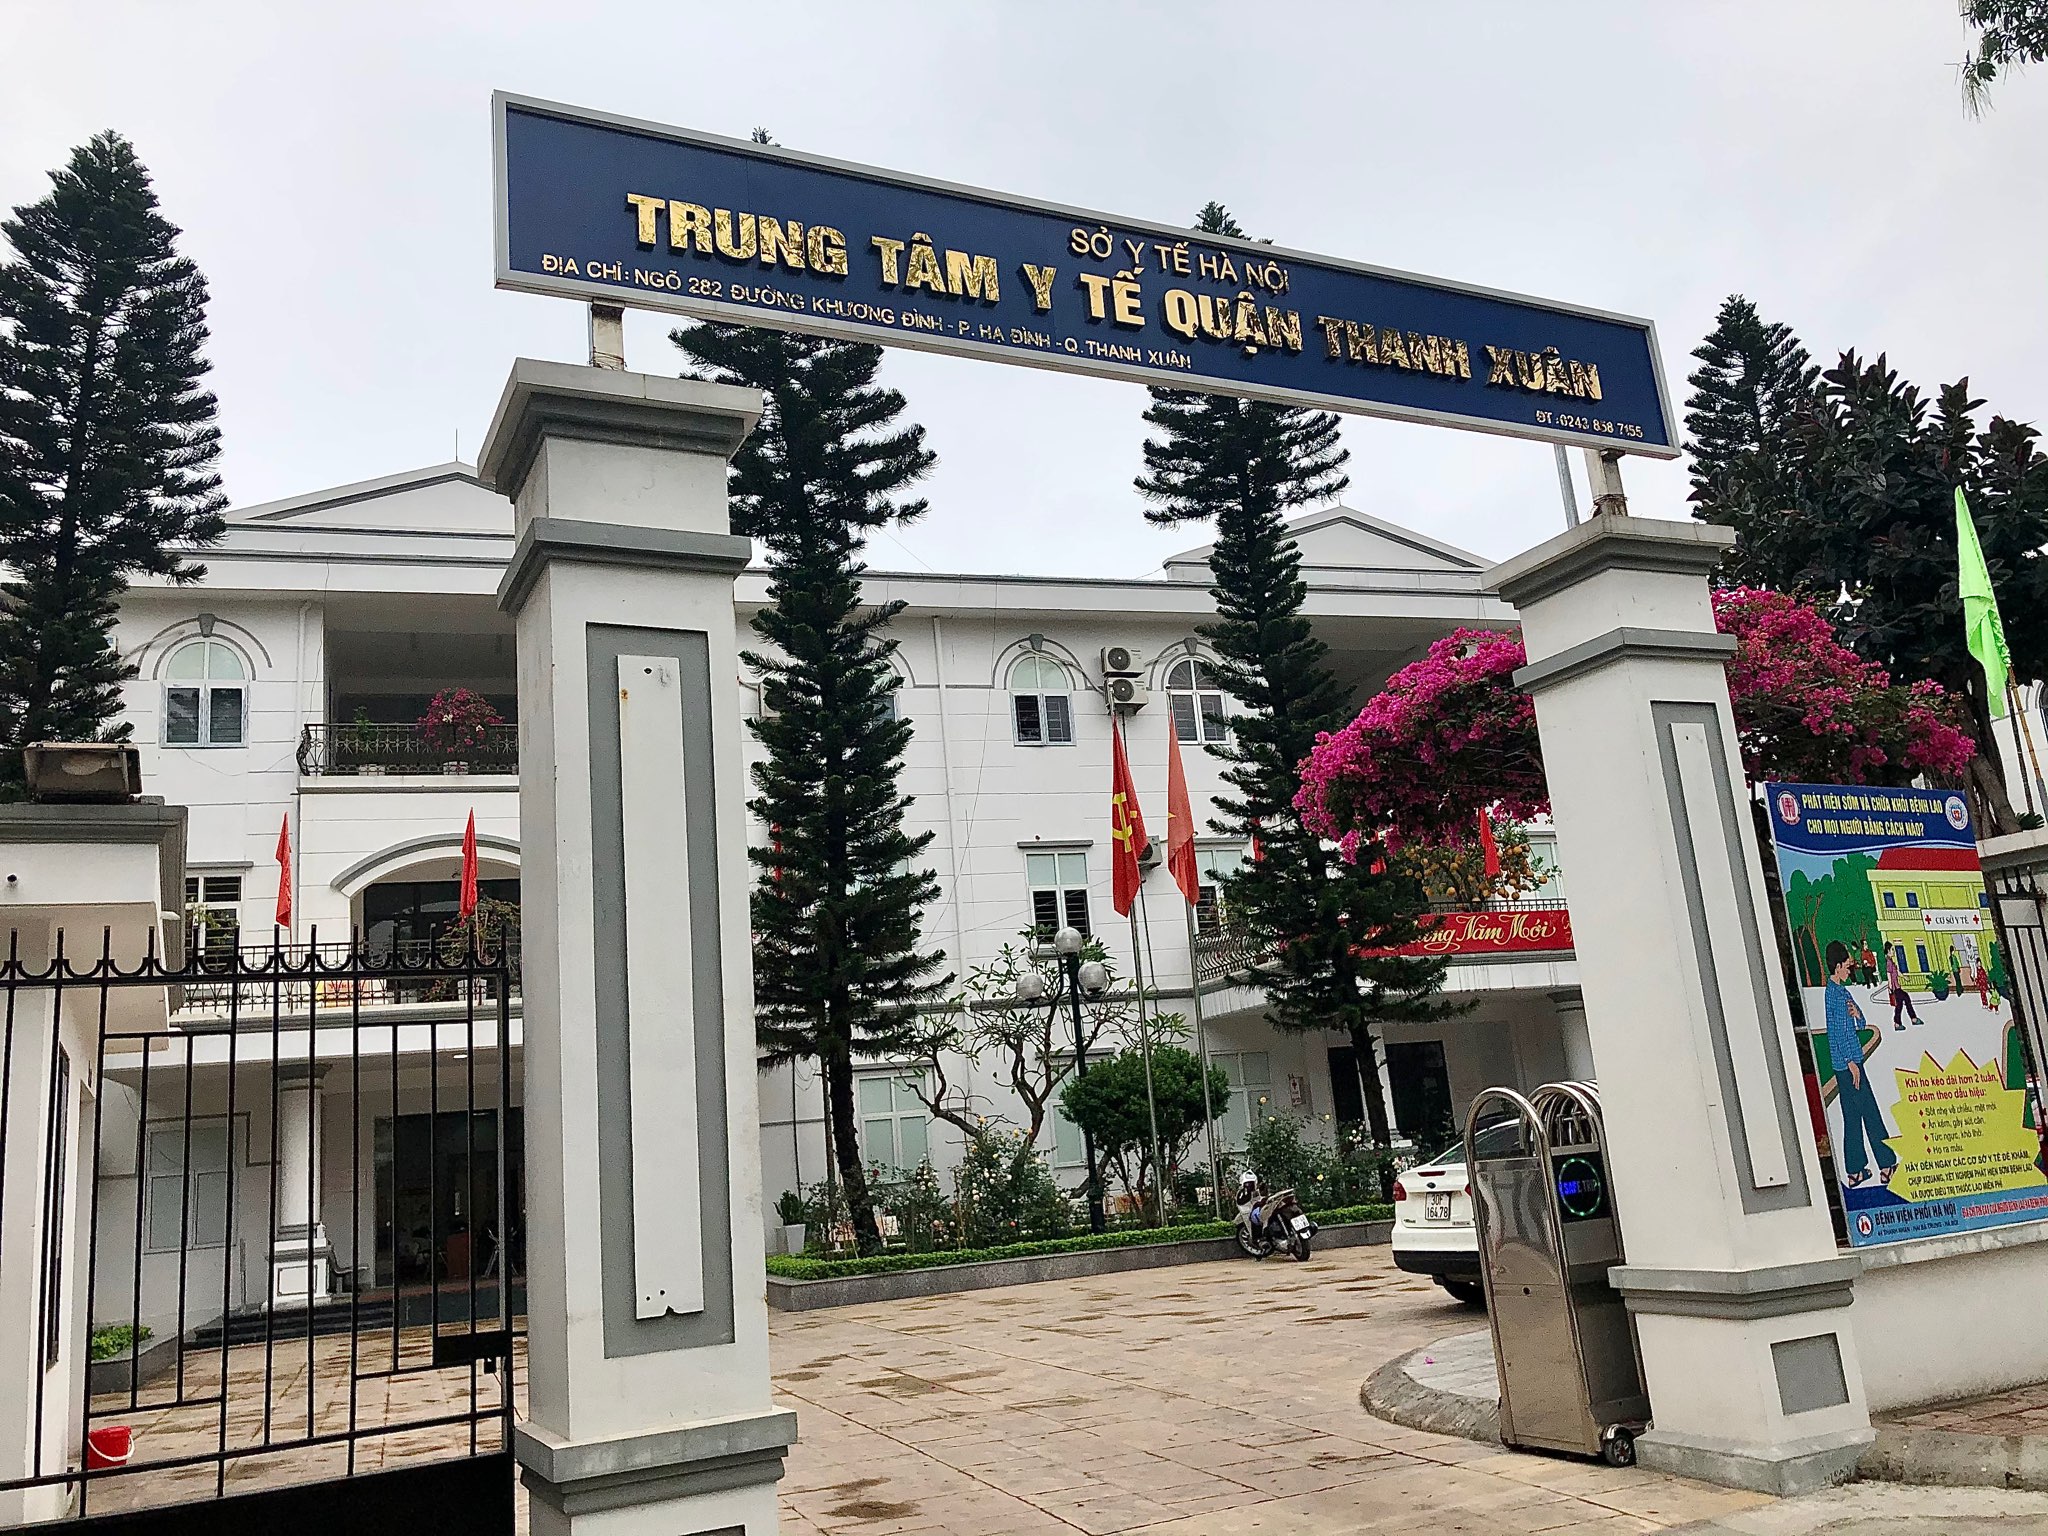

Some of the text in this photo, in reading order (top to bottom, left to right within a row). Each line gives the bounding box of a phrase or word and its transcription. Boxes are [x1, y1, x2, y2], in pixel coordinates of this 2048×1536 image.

[1071, 226, 1291, 295] SỞ Y TẾ HÀ NỘI
[627, 192, 1603, 401] TRUNG TÂM Y TẾ QUẬN THANH XUÂN
[541, 253, 580, 276] ĐỊA
[635, 268, 682, 291] NGÕ
[688, 277, 723, 298] 282
[730, 284, 805, 310] ĐƯỜNG
[812, 295, 896, 325] KHƯƠNG
[901, 308, 943, 331] ĐÌNH
[980, 324, 1006, 343] HẠ
[1011, 325, 1051, 348] ĐÌNH
[1086, 340, 1141, 362] THANH
[1148, 350, 1192, 369] XUÂN
[1593, 419, 1614, 433] 858
[1617, 423, 1643, 438] 7155
[1801, 792, 1821, 809] PHÁT
[1822, 792, 1841, 813] HIỆN
[1859, 794, 1871, 810] VÀ
[1871, 794, 1892, 812] CHỮA
[1891, 794, 1910, 812] KHỎI
[1909, 796, 1930, 816] BỆNH
[1929, 799, 1944, 814] LAO
[1806, 816, 1925, 838] CHO MỌI NGƯỜI BẰNG CÁCH NÀO?
[1955, 916, 1960, 924] Y
[1456, 915, 1504, 942] Năm
[1494, 913, 1557, 946] Mới
[1905, 1078, 1919, 1089] Khi
[1920, 1078, 1930, 1087] ho
[1931, 1076, 1945, 1087] kéo
[1946, 1075, 1958, 1085] dài
[1959, 1074, 1974, 1084] hơn
[1974, 1073, 1980, 1083] 2
[1908, 1087, 1987, 1102] có kèm theo dấu hiệu:
[1933, 1145, 1943, 1154] Ho
[1934, 1159, 1952, 1169] NGAY
[1953, 1156, 1967, 1167] CÁC
[1967, 1156, 1977, 1165] CƠ
[1993, 1152, 2001, 1162] TẾ
[2022, 1163, 2033, 1172] LAO
[1972, 1182, 1982, 1191] LAO
[1431, 1194, 1443, 1205] 30F
[1875, 1210, 1896, 1228] BỆNH
[1896, 1207, 1914, 1224] VIỆN
[1914, 1203, 1931, 1220] PHỔI
[1932, 1203, 1942, 1217] HÀ
[1943, 1201, 1957, 1218] NỘI
